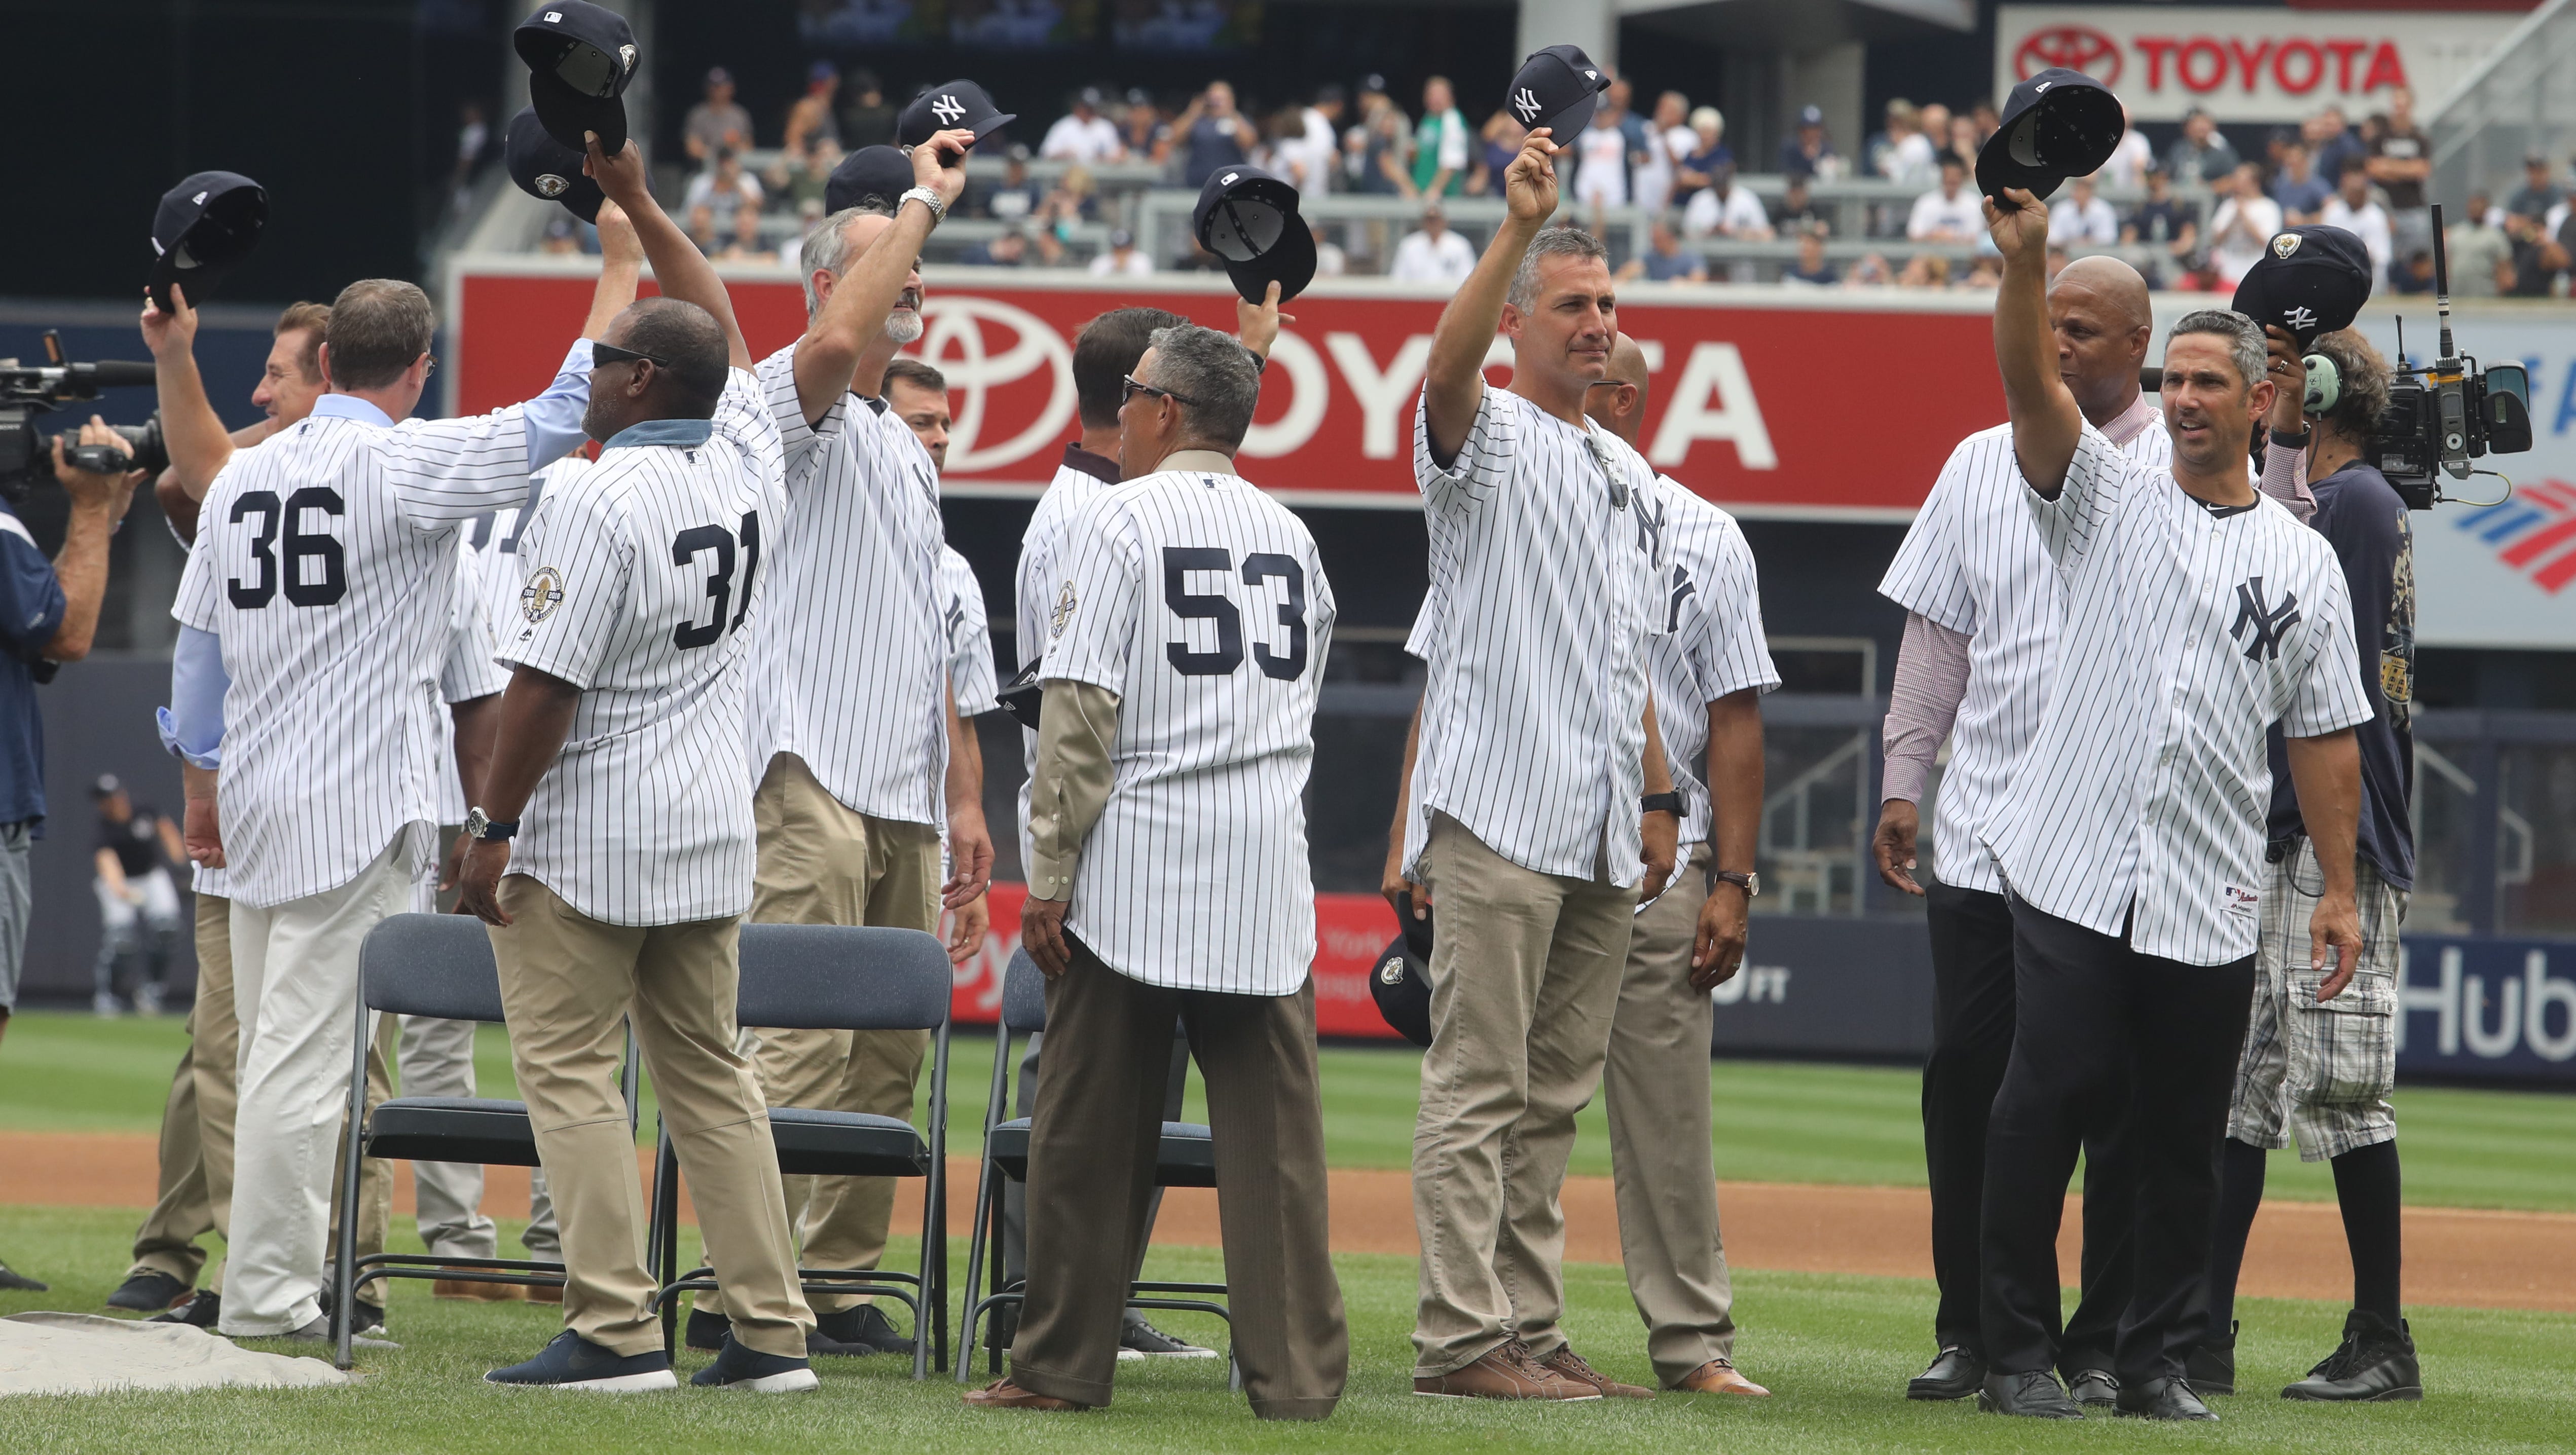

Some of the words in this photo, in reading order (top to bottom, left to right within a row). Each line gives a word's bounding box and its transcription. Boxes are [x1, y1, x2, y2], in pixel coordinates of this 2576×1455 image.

[931, 94, 966, 125] NY
[1515, 87, 1542, 123] NY
[2133, 35, 2408, 95] TOYOTA
[228, 487, 347, 610] 36
[672, 509, 760, 651] 31
[1162, 546, 1307, 682] 53
[2229, 576, 2301, 663] NY
[2394, 944, 2576, 1062] Hub
